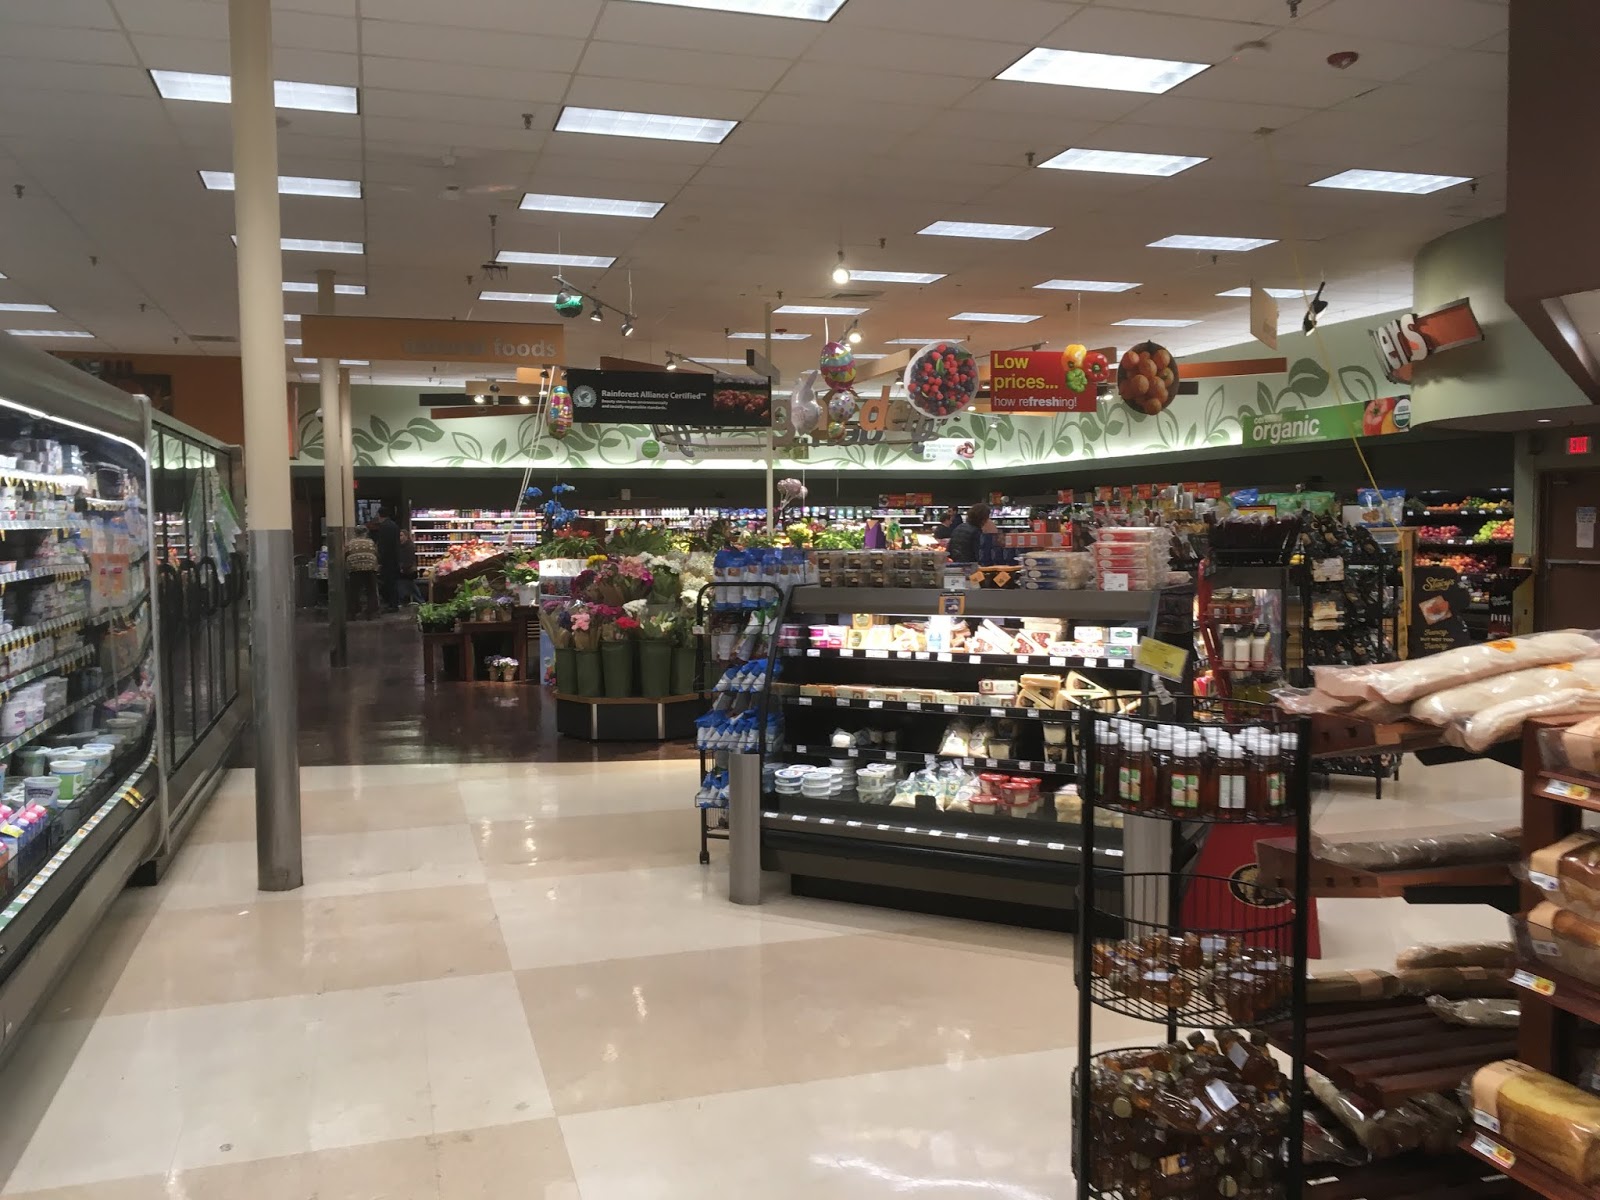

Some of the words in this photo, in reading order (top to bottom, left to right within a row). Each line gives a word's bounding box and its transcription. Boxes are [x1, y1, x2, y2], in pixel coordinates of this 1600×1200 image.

[493, 335, 557, 357] foods
[994, 353, 1029, 369] Low
[994, 375, 1058, 391] prices...
[602, 390, 639, 398] Rainforest
[640, 391, 669, 399] Alliance
[994, 397, 1016, 407] how
[1019, 396, 1077, 409] refreshing!
[1253, 414, 1320, 444] organic
[1422, 577, 1455, 591] Stacy's
